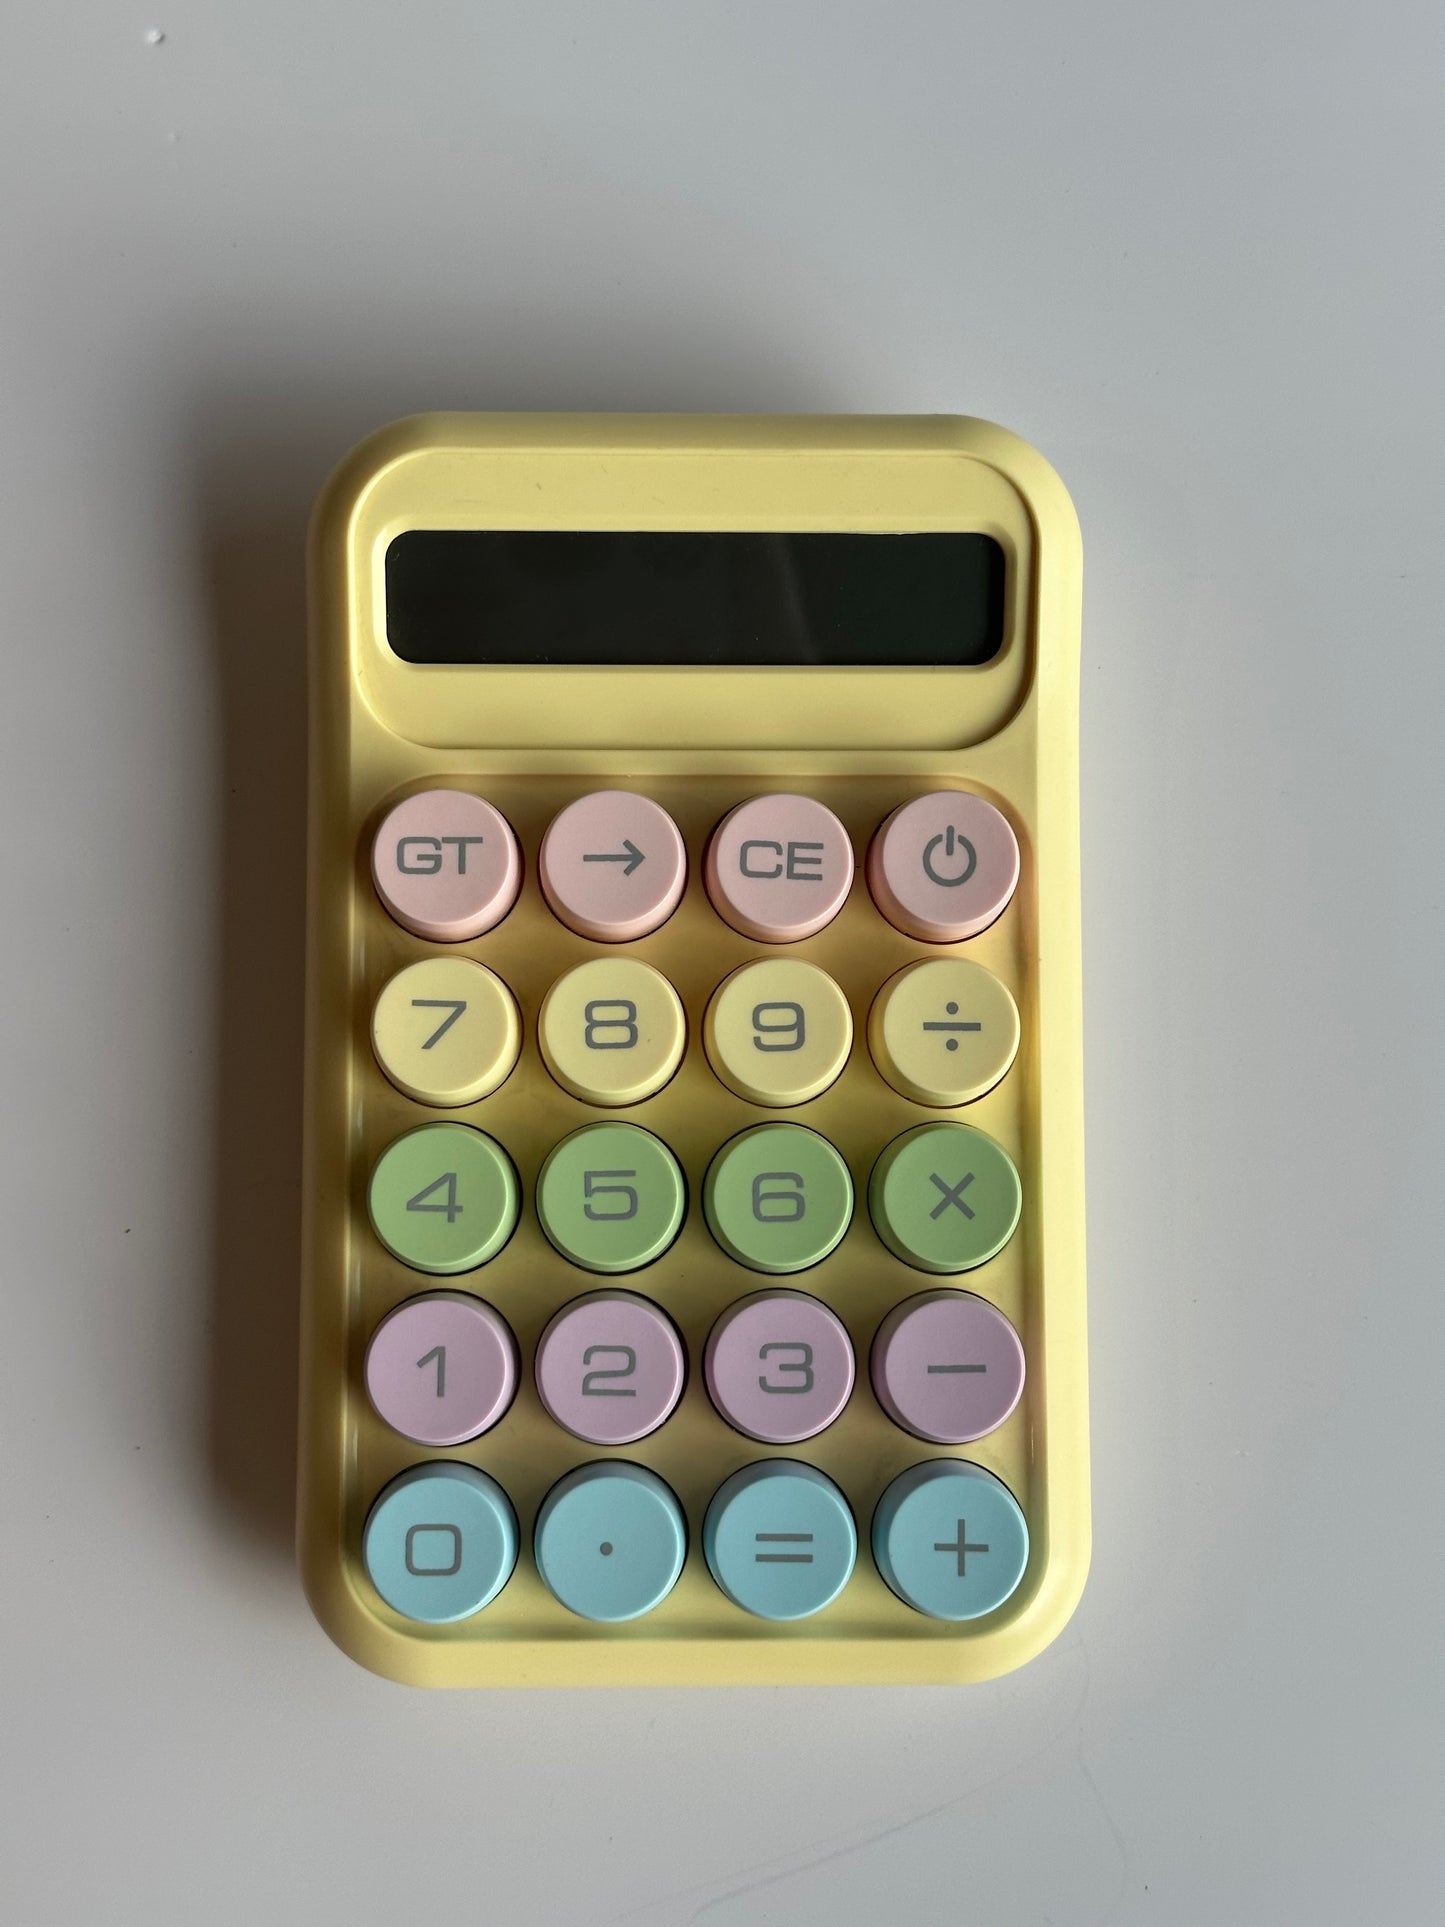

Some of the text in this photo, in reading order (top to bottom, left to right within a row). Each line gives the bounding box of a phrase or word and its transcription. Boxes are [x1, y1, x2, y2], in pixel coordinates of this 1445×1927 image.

[397, 836, 483, 875] GT
[740, 840, 825, 881] CE
[412, 999, 466, 1049] 7
[585, 999, 638, 1049] 8
[752, 1002, 805, 1052] 9
[406, 1172, 463, 1223] 4
[584, 1170, 638, 1221] 5
[752, 1172, 805, 1222] 6
[417, 1345, 447, 1398] 1
[582, 1345, 636, 1397] 2
[759, 1343, 814, 1394] 3
[405, 1523, 462, 1576] 0
